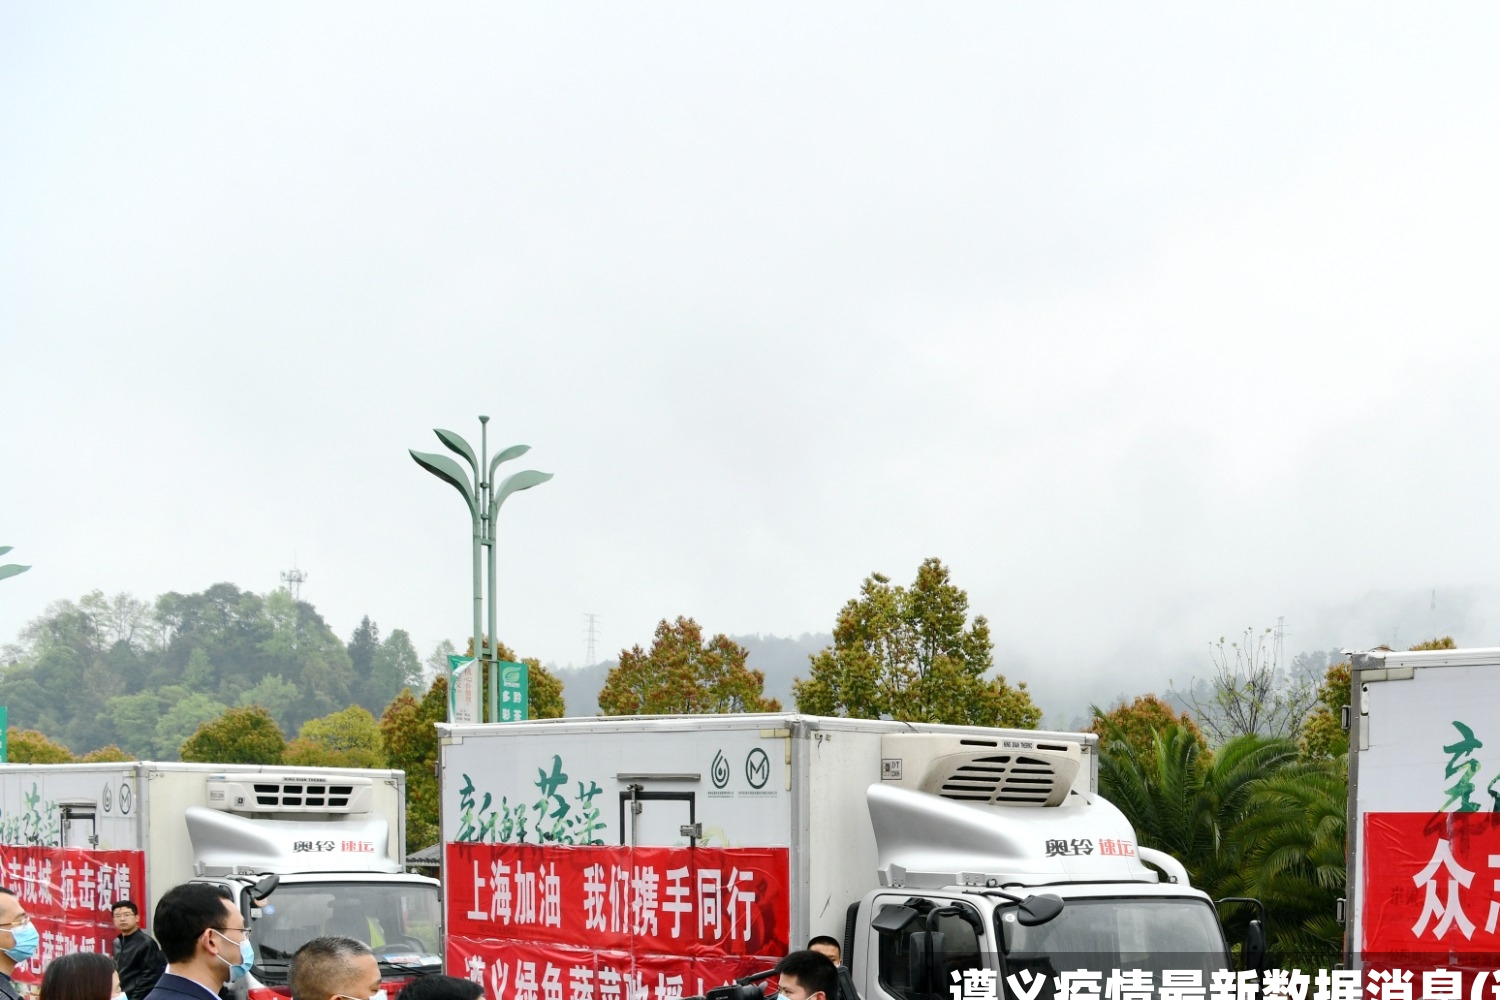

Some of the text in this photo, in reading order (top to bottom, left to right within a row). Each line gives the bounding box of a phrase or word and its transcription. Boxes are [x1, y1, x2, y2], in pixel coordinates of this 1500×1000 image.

[61, 860, 131, 912] 抗击疫情
[467, 859, 756, 942] 上海加油 我们携手同行
